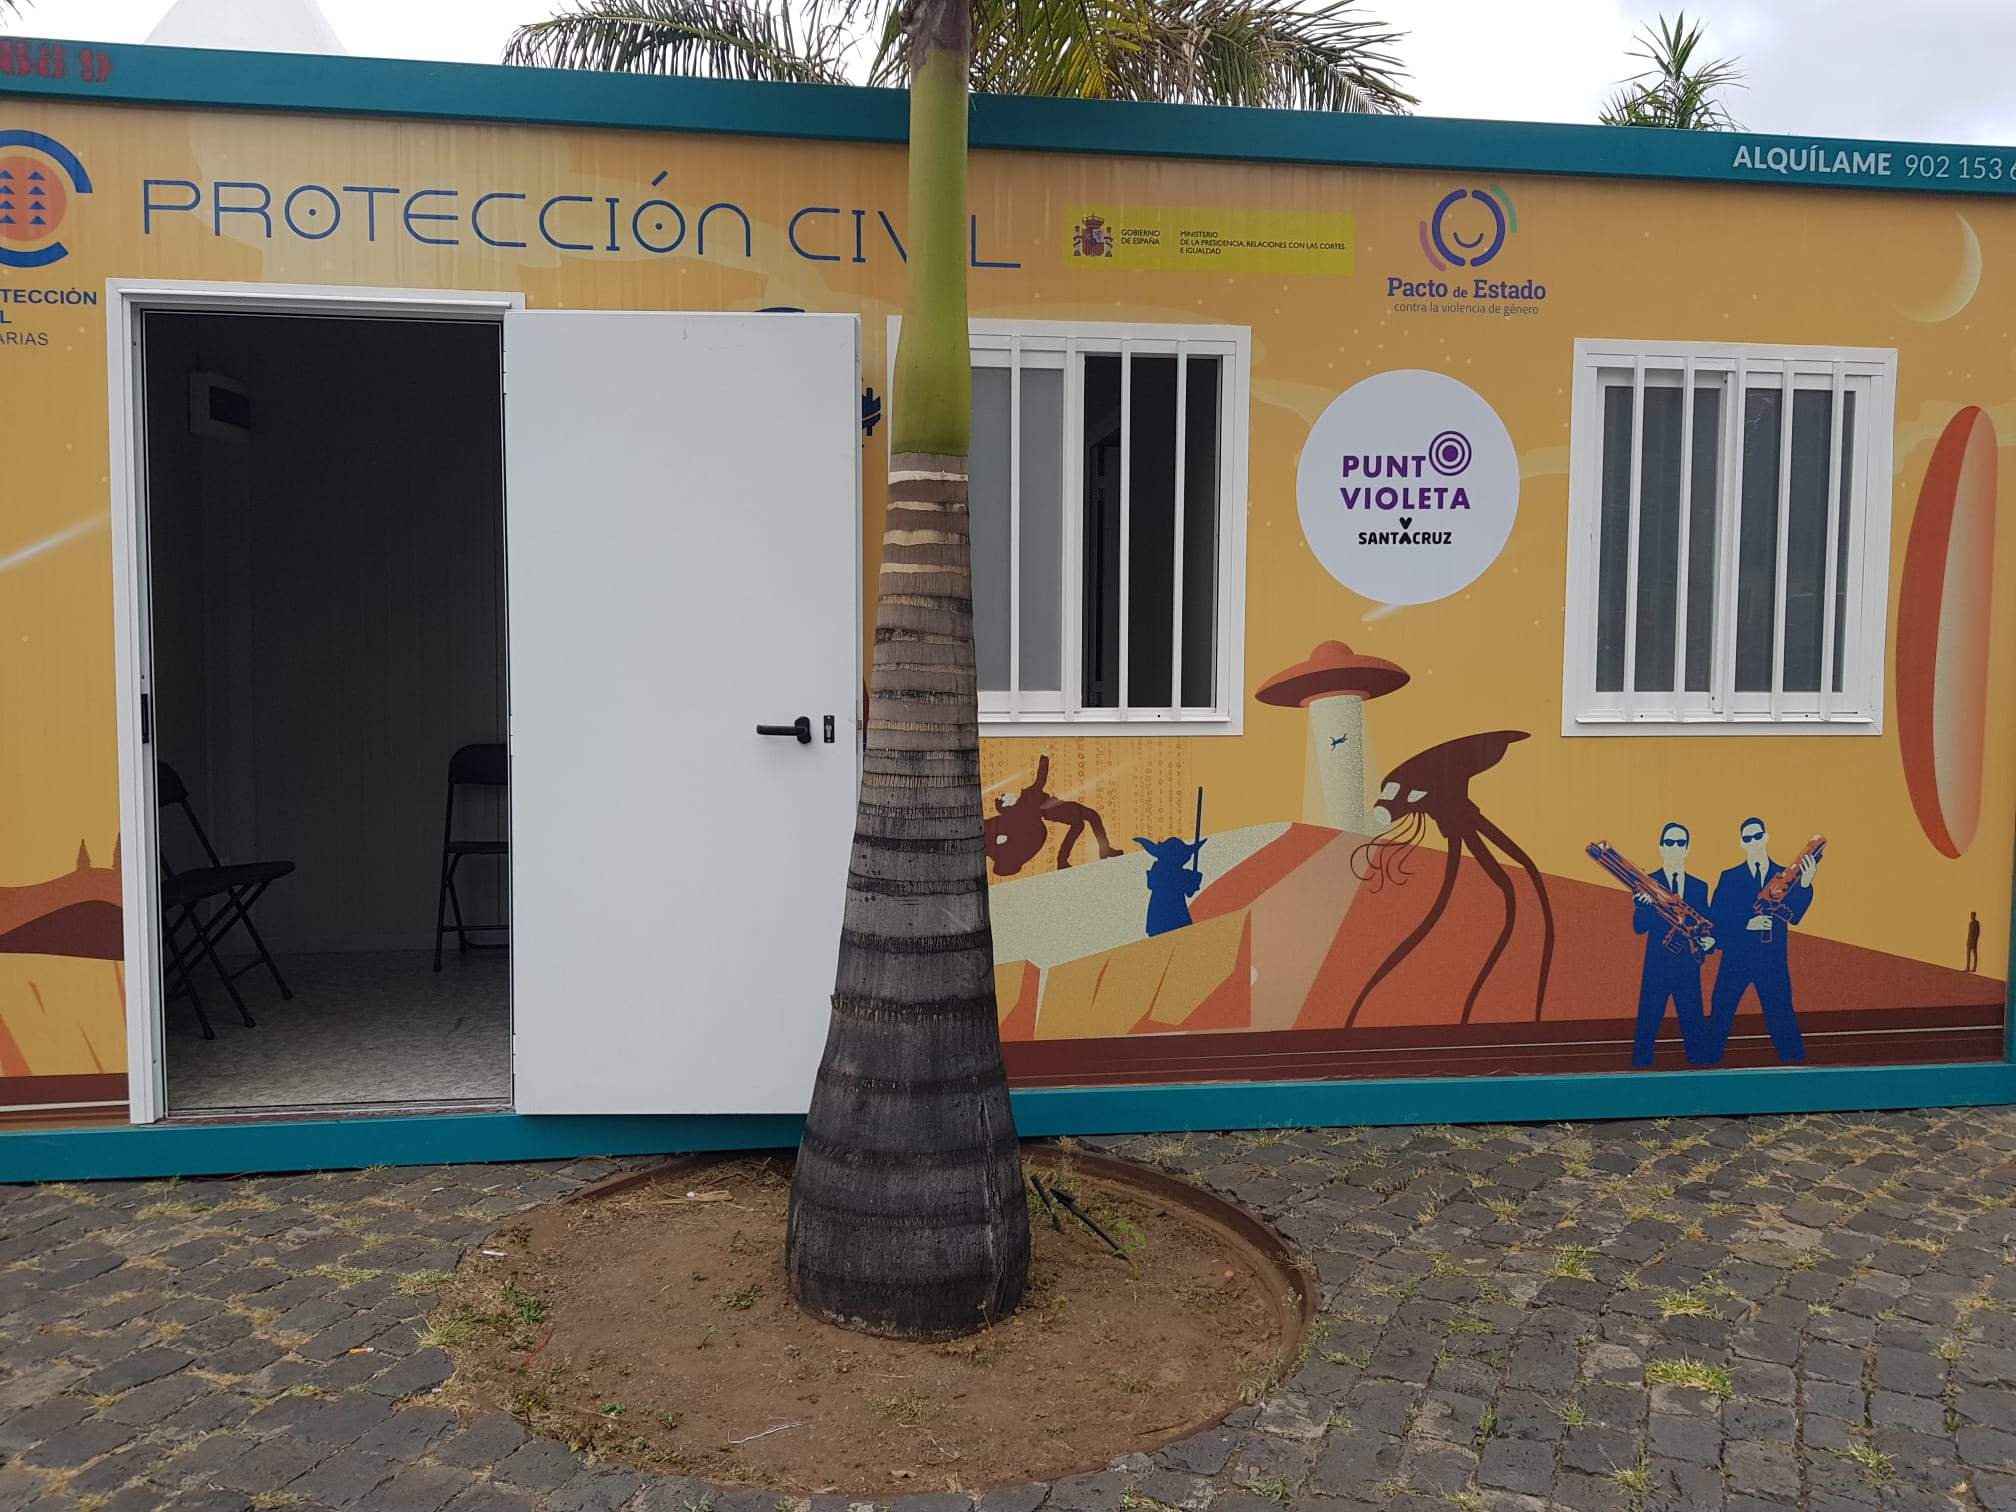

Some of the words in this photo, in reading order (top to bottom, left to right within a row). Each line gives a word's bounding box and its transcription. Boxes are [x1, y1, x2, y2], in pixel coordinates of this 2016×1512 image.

[1733, 144, 1891, 176] ALQUÍLAME
[1905, 154, 1950, 178] 902
[1959, 156, 2003, 180] 153
[143, 170, 751, 257] PROTECCIÓN
[788, 206, 1021, 268] CIVL
[1121, 229, 1160, 237] GOBIERNO
[1121, 237, 1130, 245] DE
[1132, 237, 1160, 246] ESPAÑA
[1246, 241, 1287, 249] RELACIONES
[1387, 277, 1448, 297] Pacto
[1453, 286, 1468, 298] de
[1473, 279, 1546, 300] Estado
[1394, 302, 1427, 312] contra
[1430, 302, 1439, 312] la
[1441, 302, 1486, 313] violencia
[1488, 303, 1501, 314] de
[1503, 303, 1539, 317] género
[1340, 487, 1471, 511] VIOLETA
